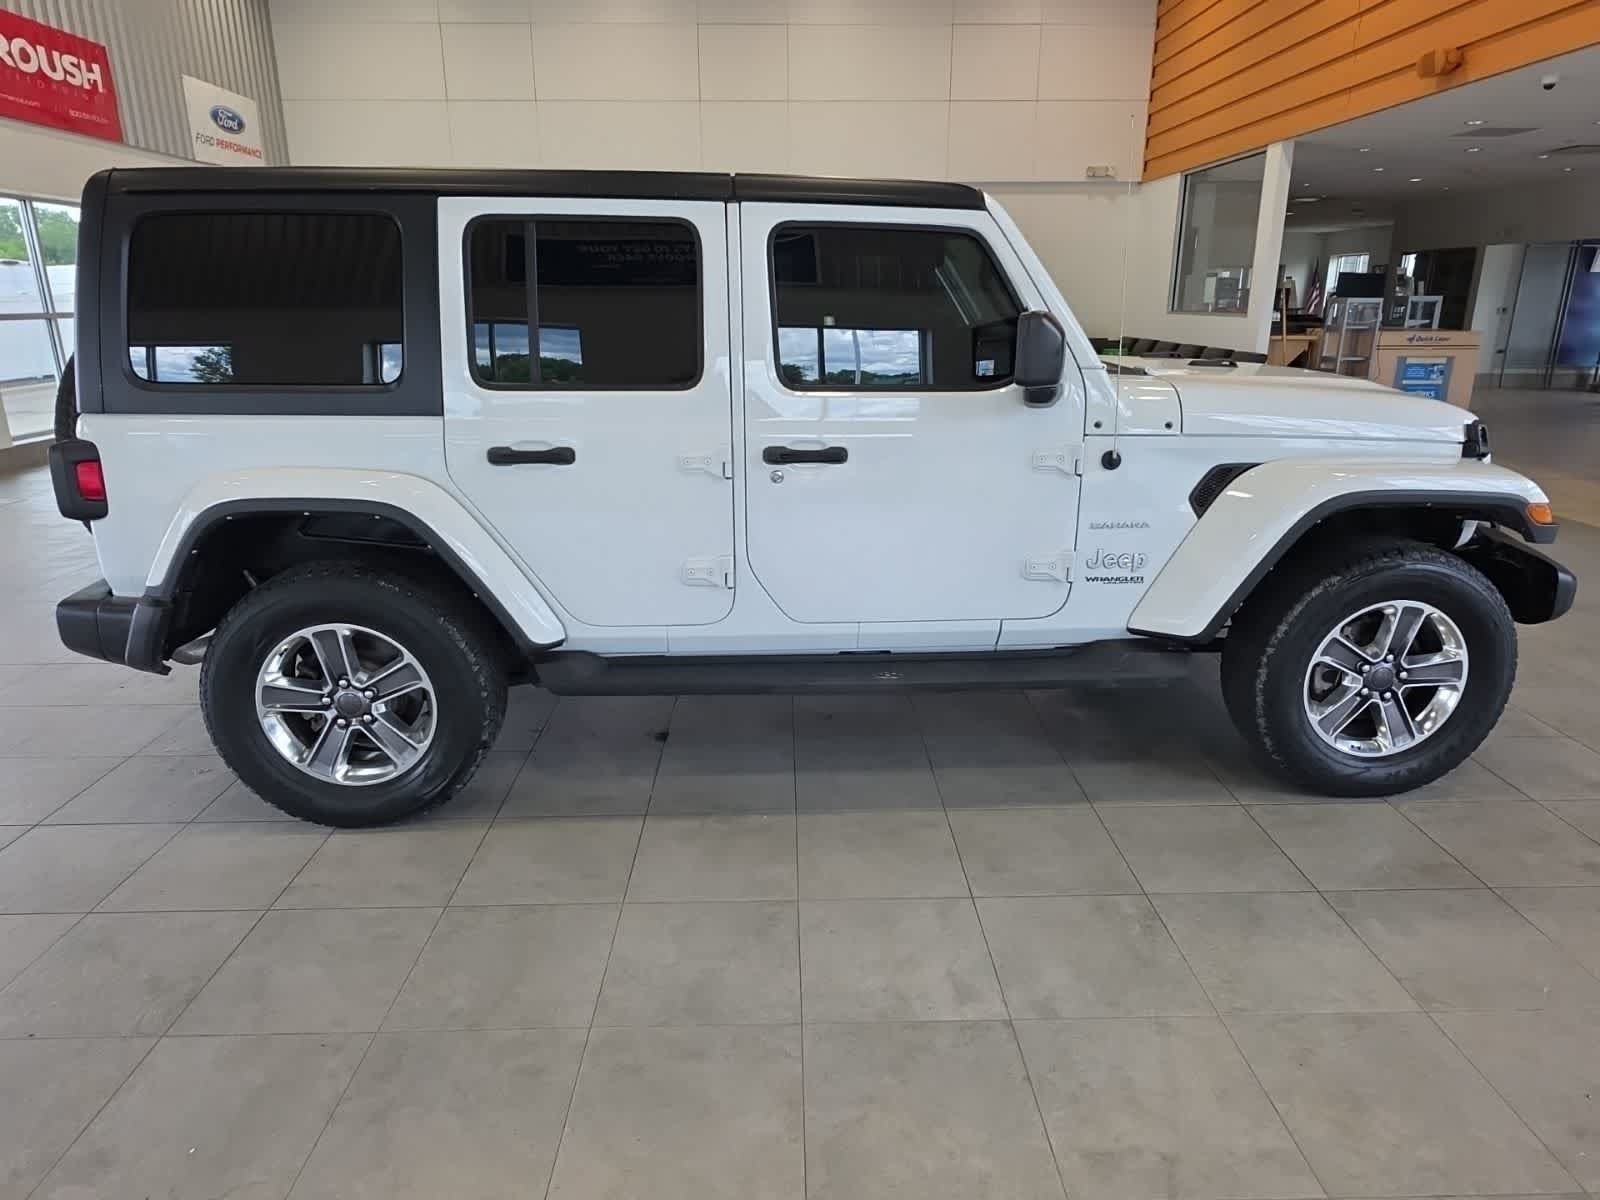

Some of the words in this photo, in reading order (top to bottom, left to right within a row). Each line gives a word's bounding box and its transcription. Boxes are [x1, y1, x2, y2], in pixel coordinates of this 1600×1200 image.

[0, 33, 104, 93] ROUSH
[217, 109, 239, 130] Ford
[195, 132, 214, 146] FORD
[1085, 548, 1148, 573] Jeep
